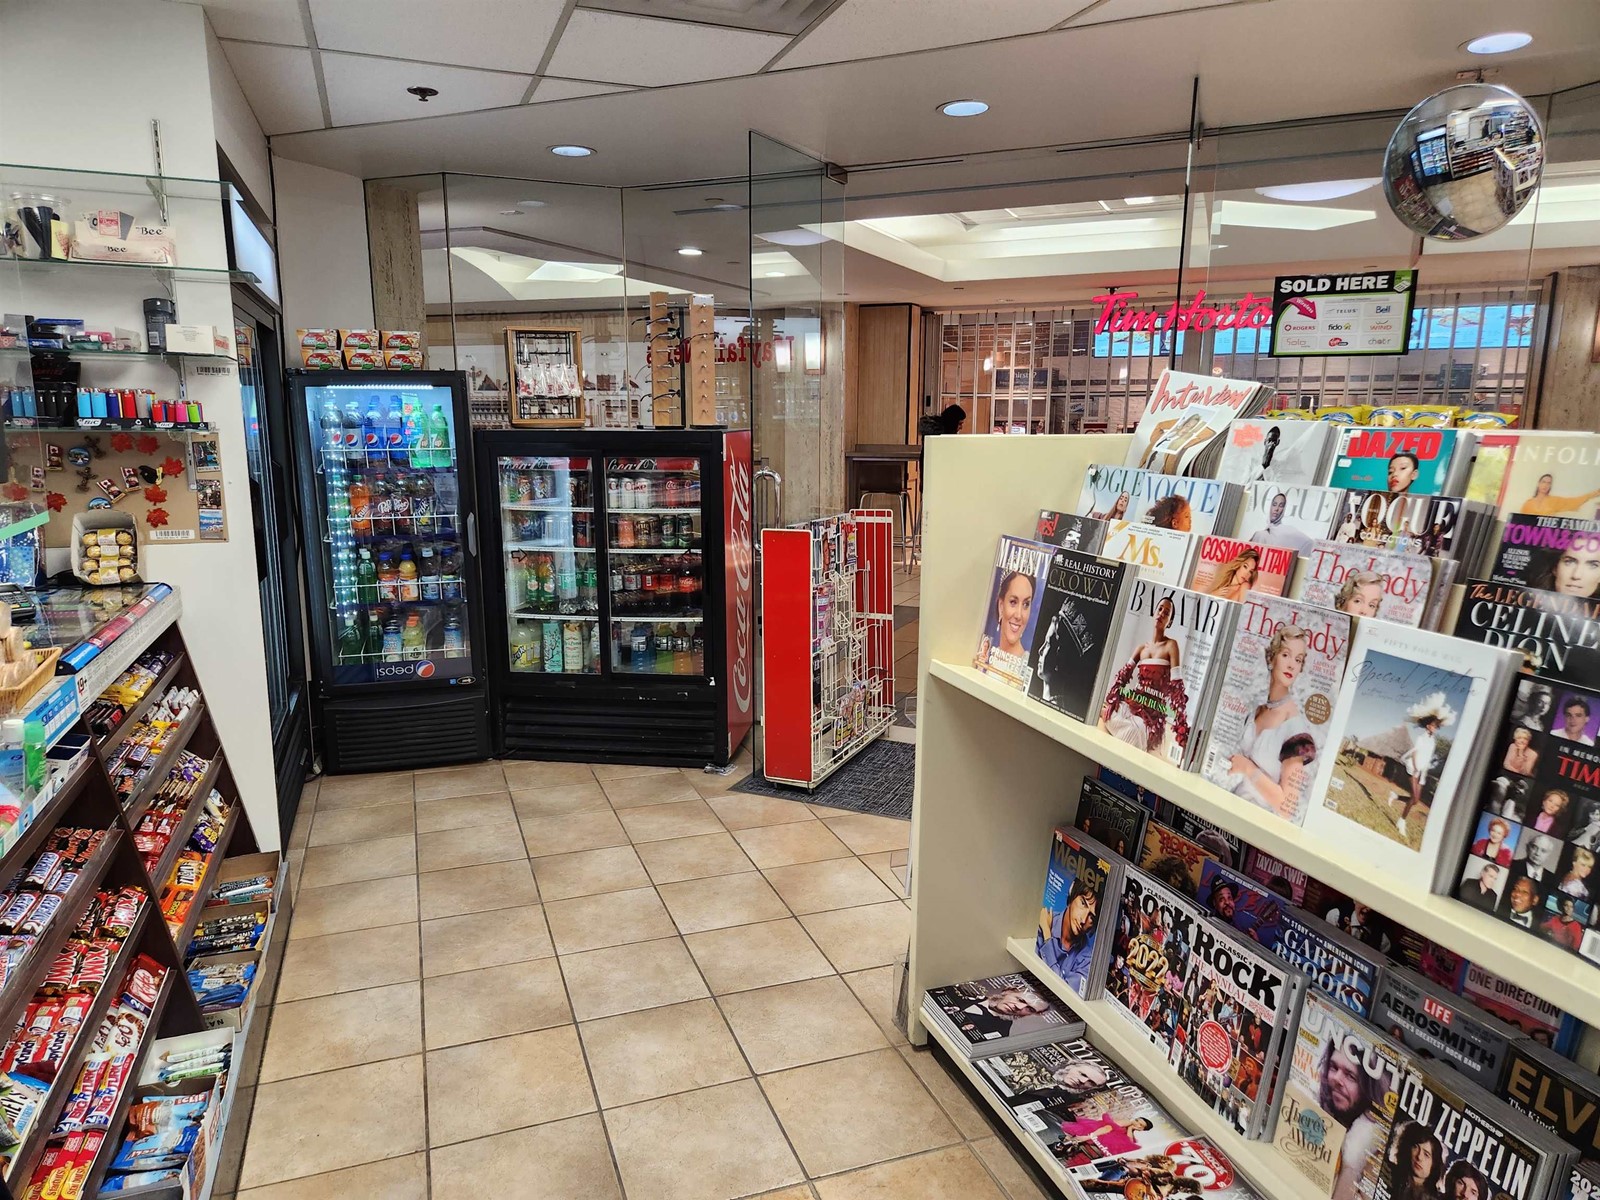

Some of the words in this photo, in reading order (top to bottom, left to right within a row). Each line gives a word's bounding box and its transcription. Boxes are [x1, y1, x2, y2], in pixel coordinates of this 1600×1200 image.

[1280, 278, 1331, 293] SOLD
[1335, 275, 1390, 291] HERE
[1092, 291, 1156, 335] Tim
[1328, 323, 1343, 331] fido
[1375, 305, 1391, 314] Bell
[1286, 338, 1307, 346] Solo
[1151, 372, 1252, 415] Interview
[1360, 531, 1422, 548] COLLECTIONS
[1537, 516, 1559, 528] THE
[996, 538, 1053, 580] MAJESTY
[1064, 557, 1082, 571] REAL
[1083, 561, 1117, 579] HISTORY
[1117, 534, 1164, 570] Ms.
[1312, 549, 1360, 586] The
[729, 442, 752, 714] Coca-Cola
[1049, 569, 1115, 600] CROWN
[1470, 584, 1493, 600] The
[1244, 600, 1285, 637] The
[1471, 601, 1600, 649] CELINE
[376, 663, 415, 678] pepsi
[1559, 746, 1570, 754] IN
[1054, 840, 1105, 892] Weller
[1255, 853, 1284, 878] TAYLOR
[106, 897, 138, 928] TWIX
[1125, 875, 1195, 945] ROCK
[1147, 889, 1171, 907] CLASSIC
[1127, 938, 1170, 980] 2022
[1220, 941, 1249, 963] CLASSIC
[1284, 929, 1360, 990] GARTH
[1291, 920, 1309, 936] STORY
[1323, 941, 1353, 964] AMERICAN
[1353, 961, 1369, 974] ICON
[42, 950, 77, 986] TWIX
[70, 949, 109, 988] TWIX
[1193, 923, 1282, 1012] ROCK
[1274, 940, 1364, 1013] BROOKS
[1423, 998, 1452, 1025] LIFE
[1468, 969, 1492, 989] ONE
[1494, 980, 1561, 1018] DIRECTION
[1301, 1005, 1405, 1090] UNCUT
[1380, 992, 1496, 1069] AEROSMITH
[1387, 1010, 1415, 1033] AMERICA'S
[1415, 1029, 1444, 1051] GREATEST
[1446, 1046, 1463, 1061] ROCK
[1463, 1057, 1481, 1072] BAND
[1400, 1075, 1434, 1127] LED
[1508, 1057, 1600, 1150] ELV
[1508, 1098, 1526, 1114] The
[1465, 1108, 1504, 1138] MOTHERSHIP
[1433, 1103, 1533, 1200] ZEPPELIN
